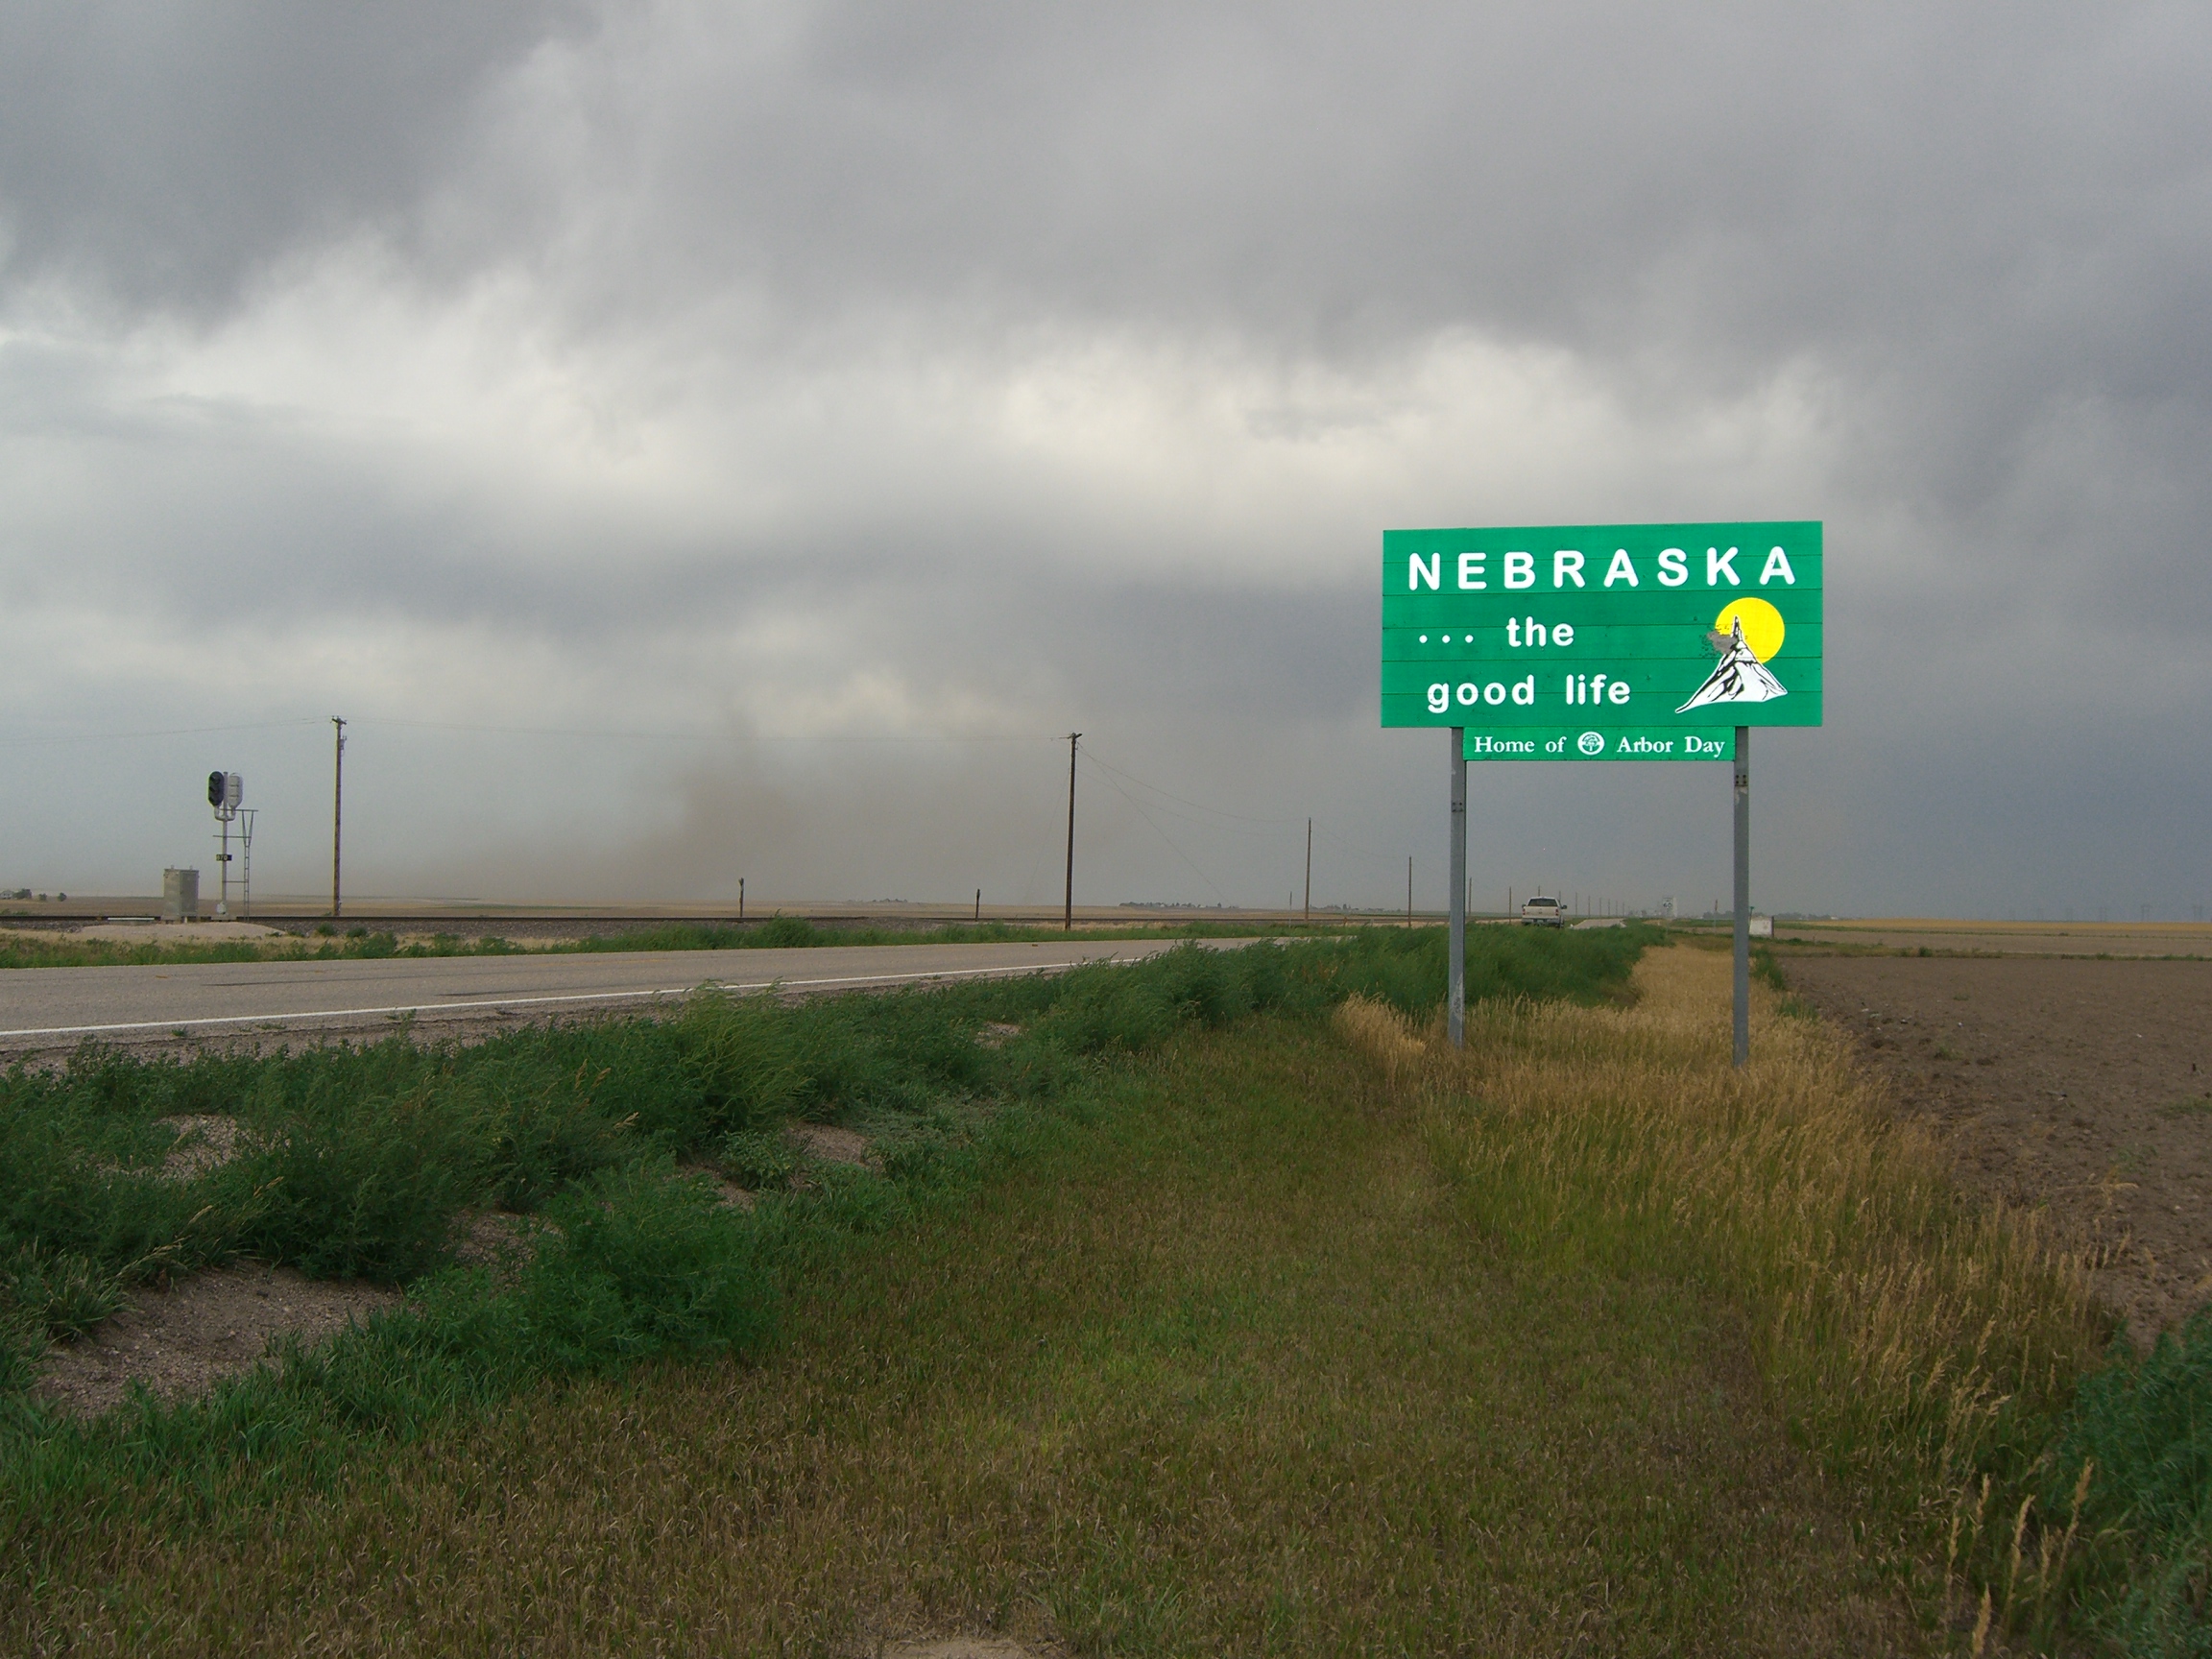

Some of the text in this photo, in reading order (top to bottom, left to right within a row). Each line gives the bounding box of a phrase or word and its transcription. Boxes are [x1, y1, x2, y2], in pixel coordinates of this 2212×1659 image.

[1408, 545, 1795, 591] NEBRASKA
[1506, 615, 1575, 648] the
[1427, 673, 1631, 714] good life
[1474, 736, 1726, 758] Home of Arbor Day
